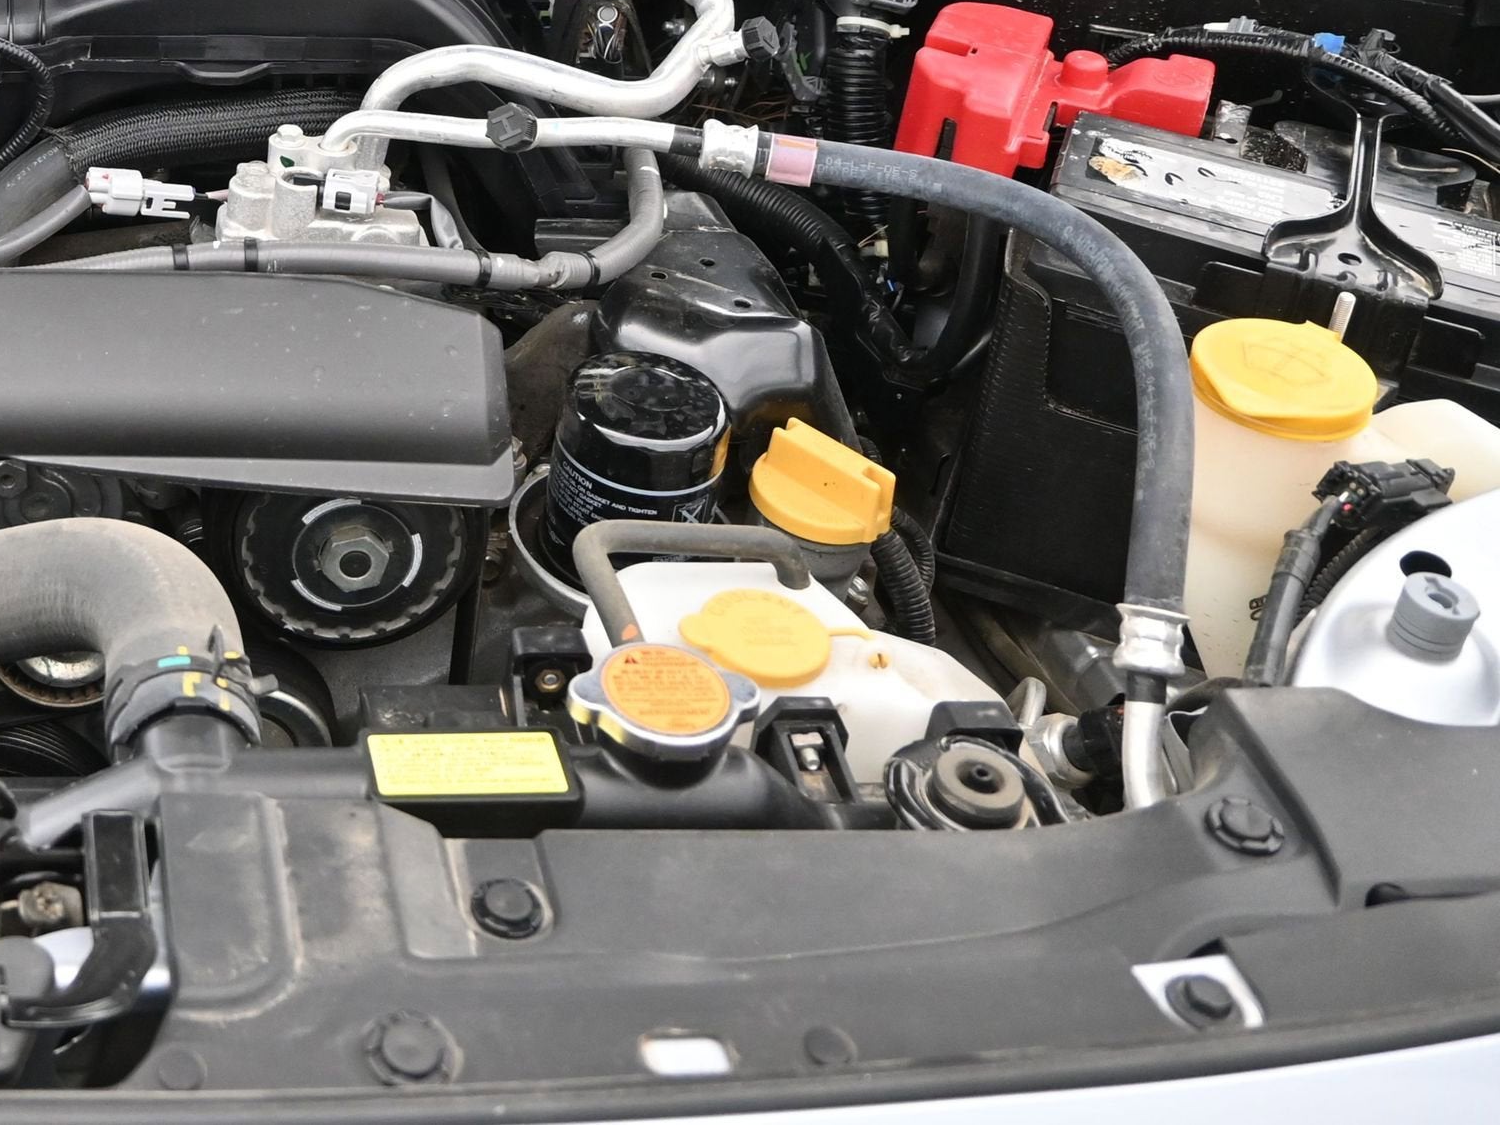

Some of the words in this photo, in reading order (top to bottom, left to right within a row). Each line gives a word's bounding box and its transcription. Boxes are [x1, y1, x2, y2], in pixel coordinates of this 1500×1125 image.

[563, 461, 592, 489] CAUTION
[587, 490, 610, 505] GASKET
[611, 503, 626, 512] AND
[628, 506, 657, 515] TIGHTEN
